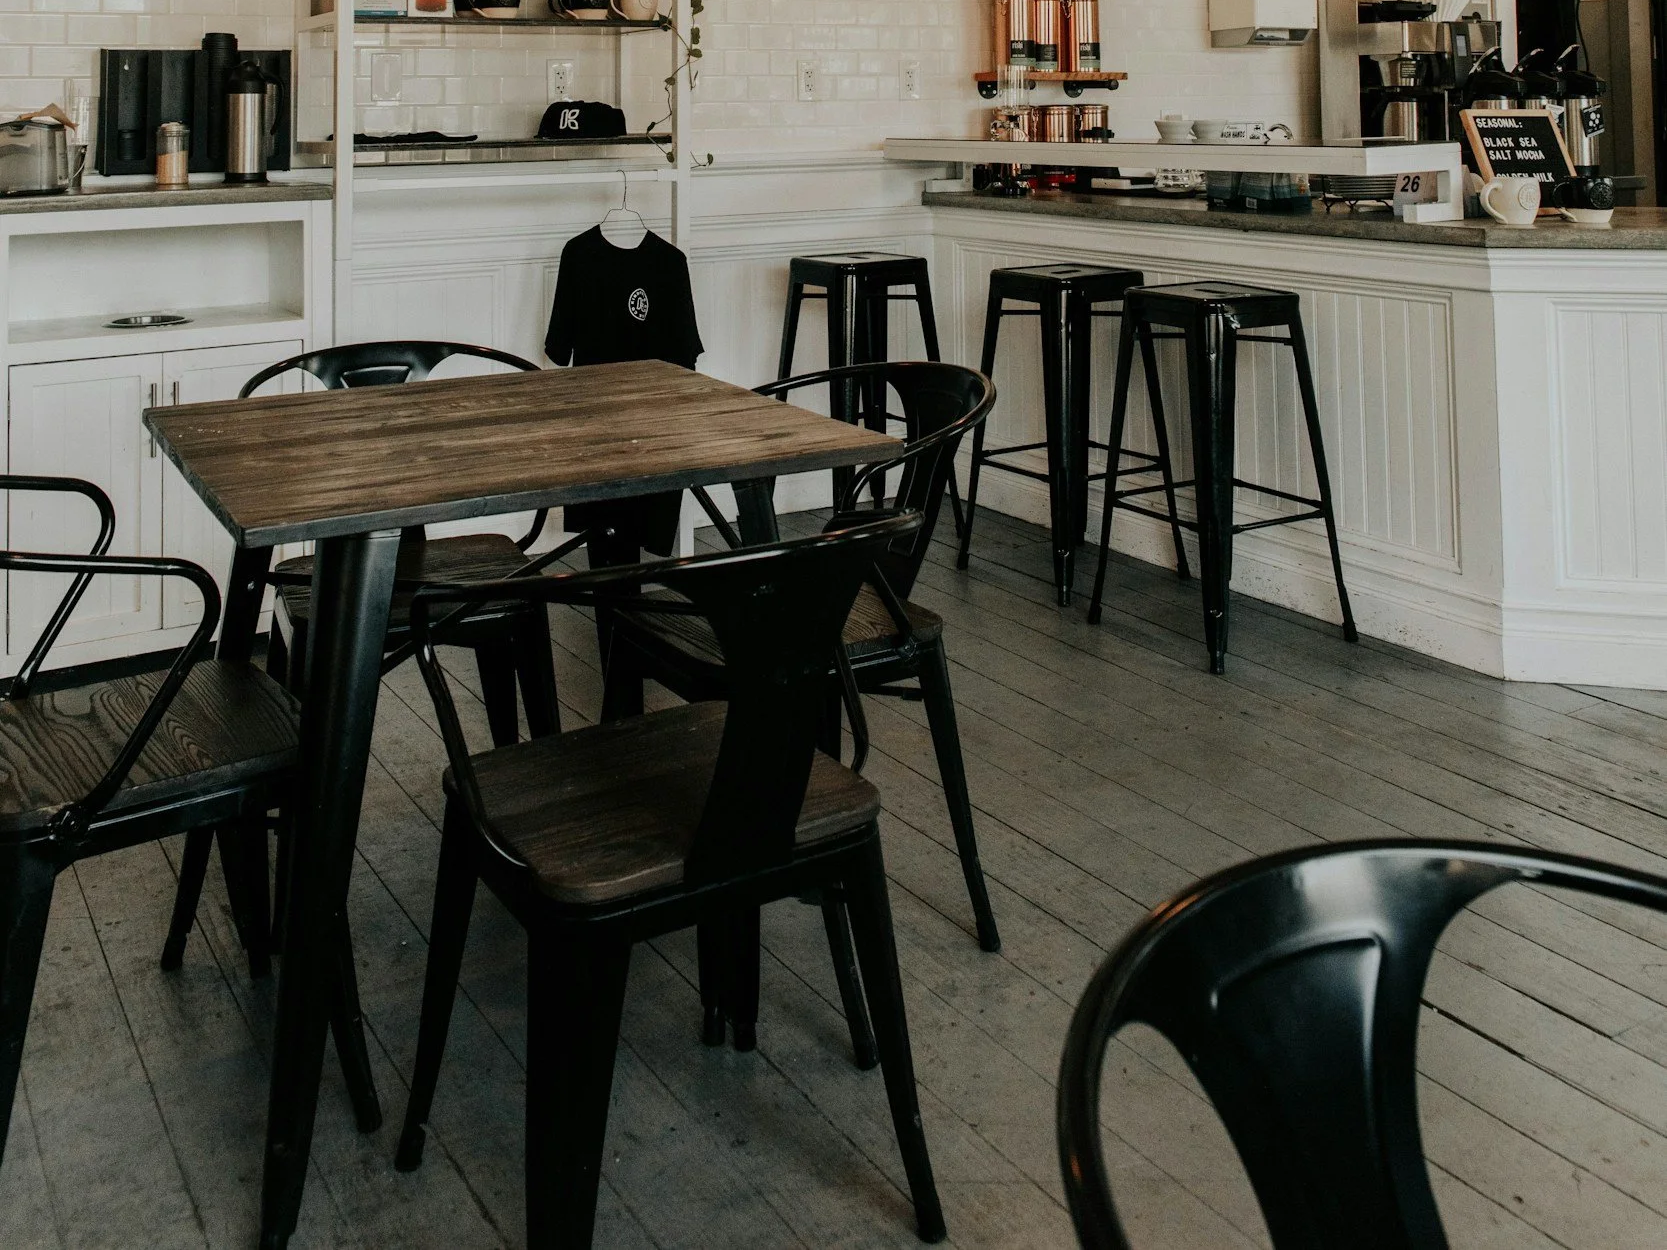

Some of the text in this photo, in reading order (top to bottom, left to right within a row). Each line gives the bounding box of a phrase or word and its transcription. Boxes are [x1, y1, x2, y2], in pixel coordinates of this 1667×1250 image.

[1475, 118, 1523, 128] SEASONAL:
[1483, 137, 1538, 148] BLACK SEA
[1489, 150, 1546, 161] SALT MOCHA
[1400, 175, 1420, 193] 26
